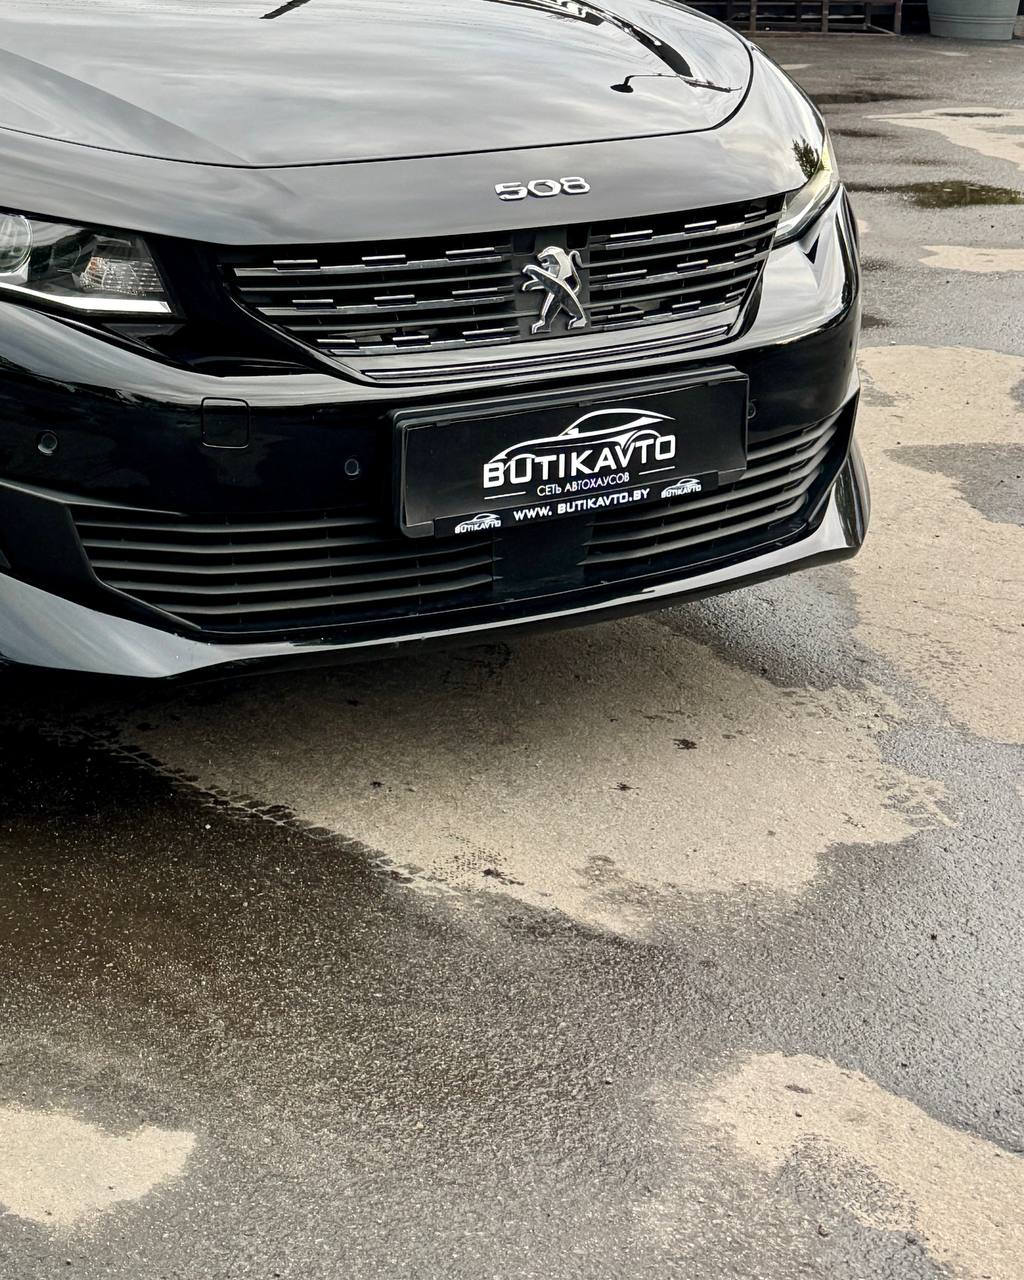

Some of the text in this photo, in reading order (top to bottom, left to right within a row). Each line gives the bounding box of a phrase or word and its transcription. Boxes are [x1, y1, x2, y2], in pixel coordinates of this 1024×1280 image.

[494, 176, 591, 201] 508
[482, 434, 676, 488] BUTIKAVTO
[536, 471, 630, 497] СЕТЬ АВТОХАУСОВ
[660, 482, 702, 499] BUTIKAVTO
[513, 488, 650, 521] WWW. BUTIKAVTO.BY
[454, 519, 502, 535] BUTIKAVTO
